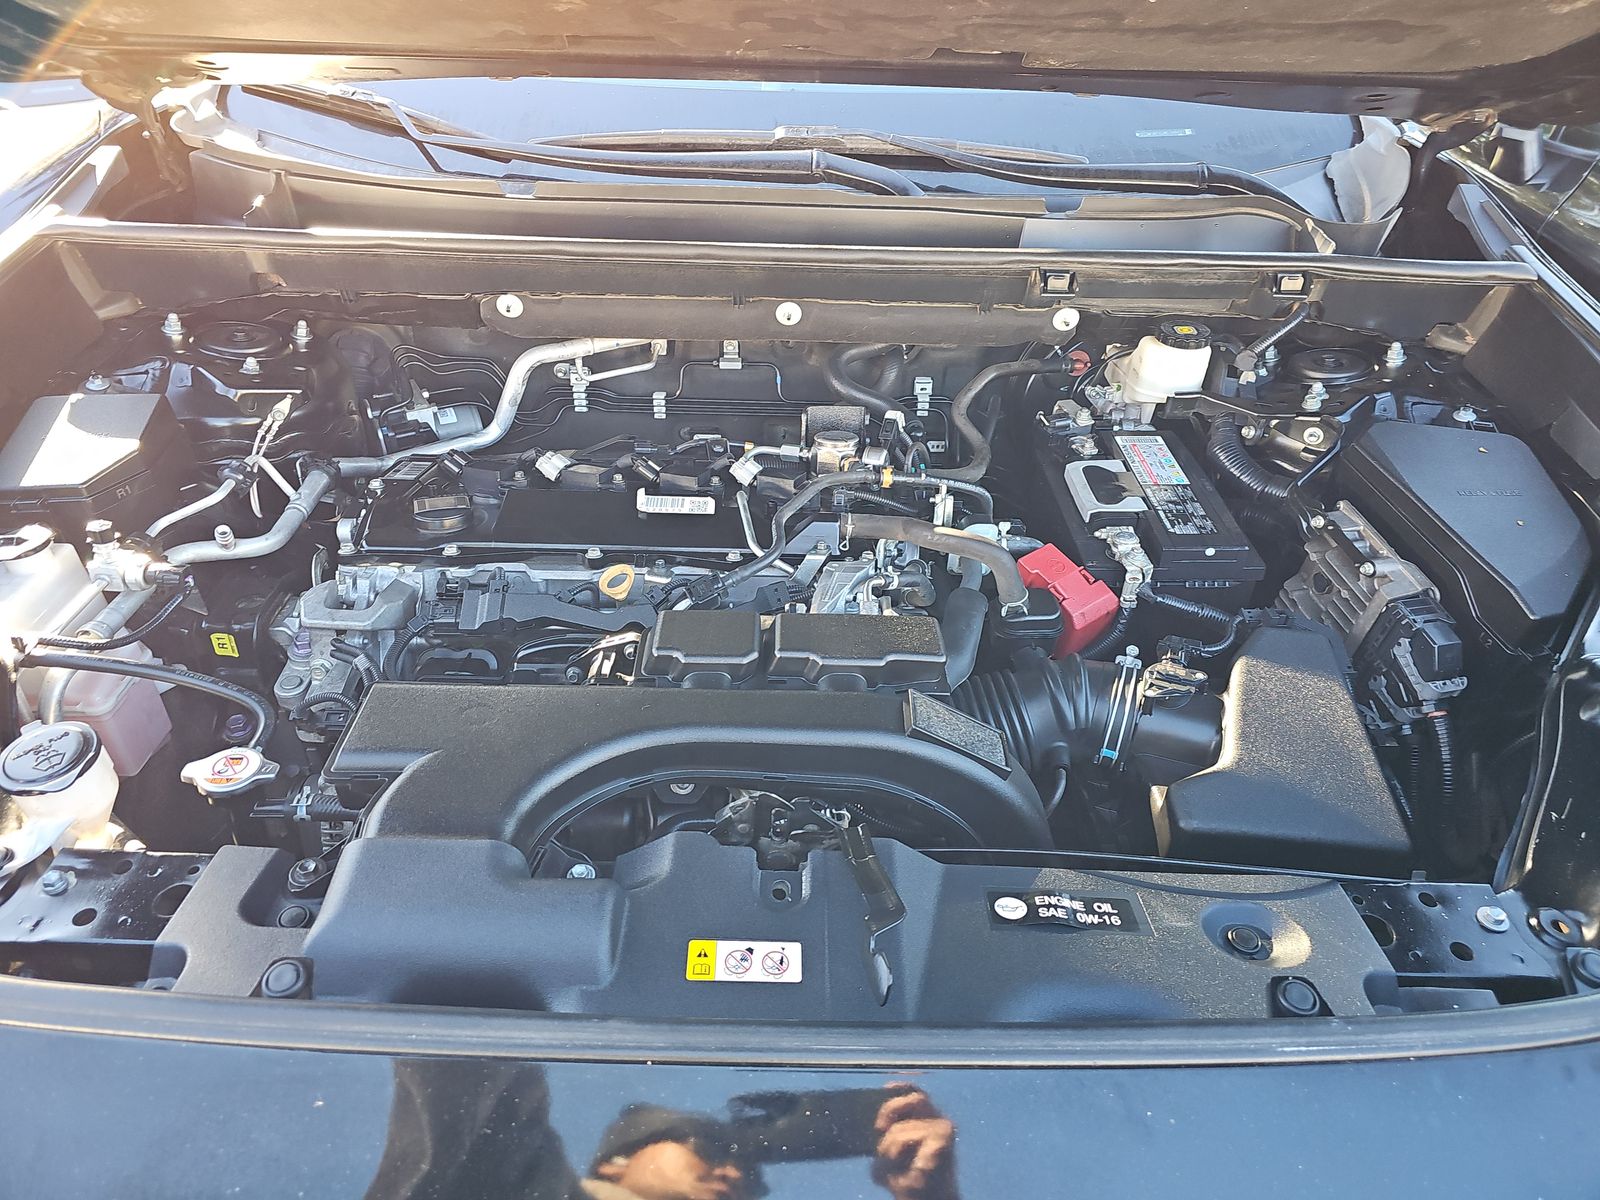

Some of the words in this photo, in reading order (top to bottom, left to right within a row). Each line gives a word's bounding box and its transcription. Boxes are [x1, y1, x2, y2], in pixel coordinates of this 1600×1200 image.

[115, 484, 132, 500] R1
[216, 636, 229, 650] R1
[1034, 895, 1087, 912] ENGINE
[1093, 902, 1119, 914] OIL
[1038, 907, 1069, 919] SAE
[1076, 912, 1122, 926] 0W-16
